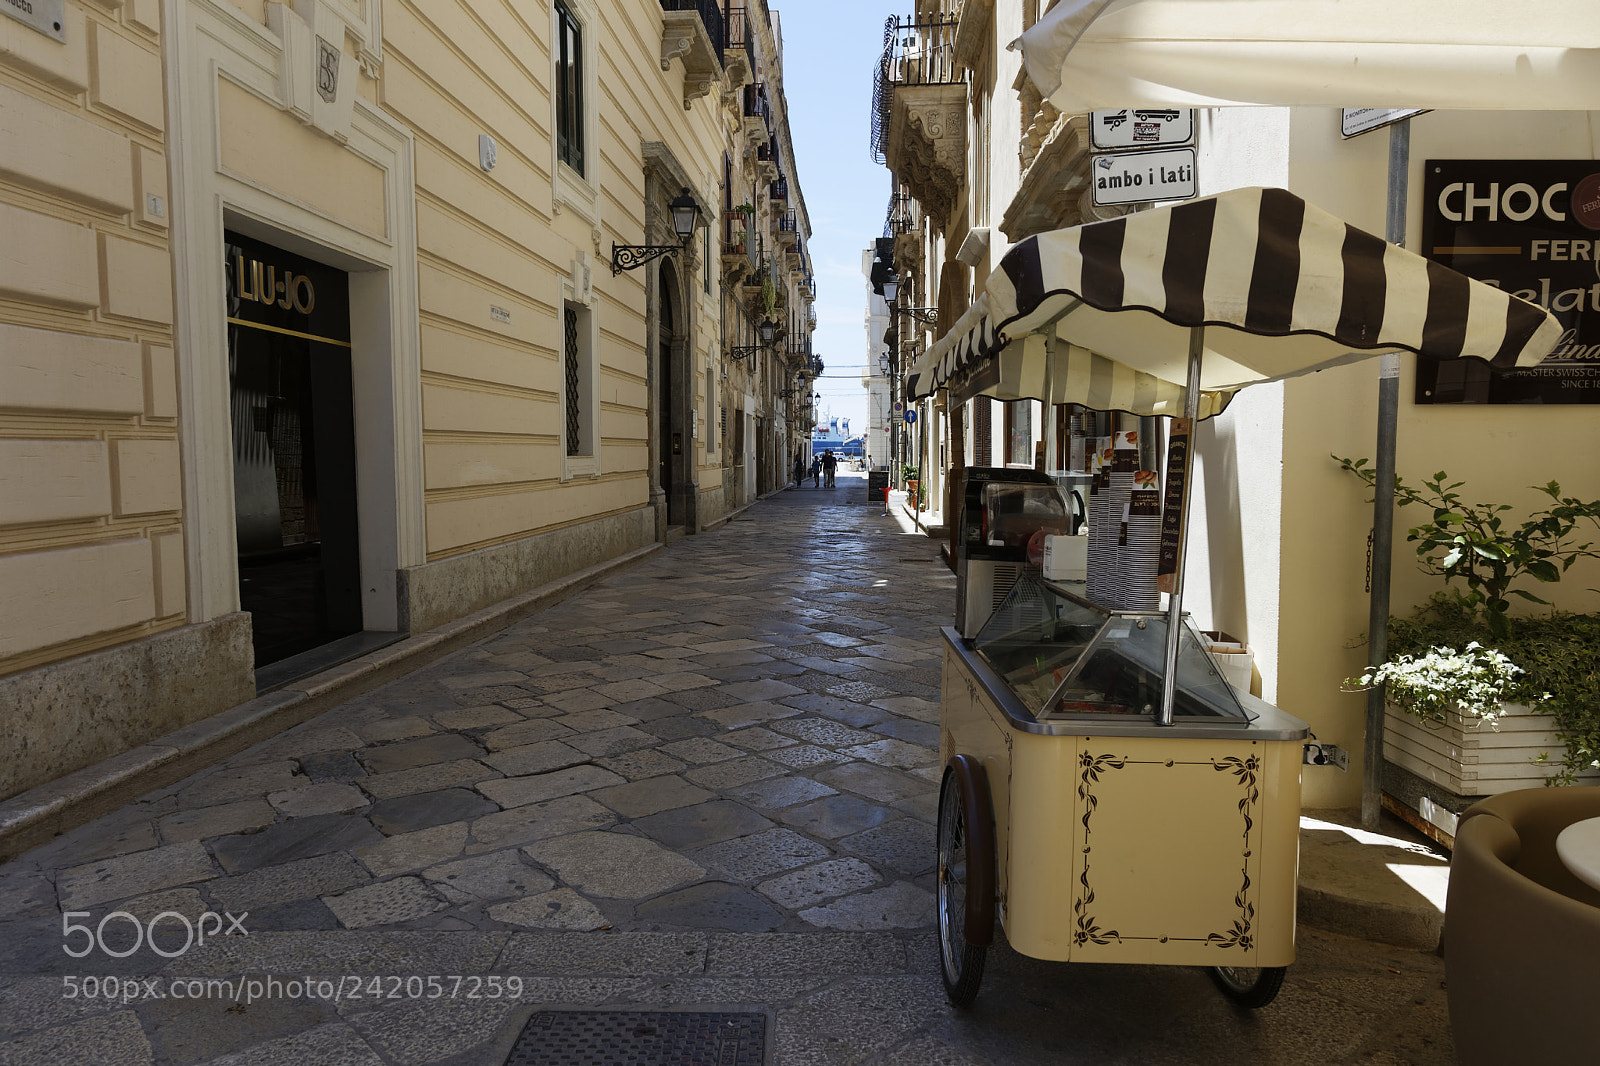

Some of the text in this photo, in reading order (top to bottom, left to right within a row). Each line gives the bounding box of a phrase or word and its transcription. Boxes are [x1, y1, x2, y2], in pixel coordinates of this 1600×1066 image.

[5, 0, 33, 14] OCCO
[1098, 165, 1191, 189] ambo i lati
[1438, 183, 1567, 221] CHOC
[1480, 278, 1600, 312] elat
[1556, 369, 1585, 377] SWISS
[1561, 380, 1589, 389] SINCE
